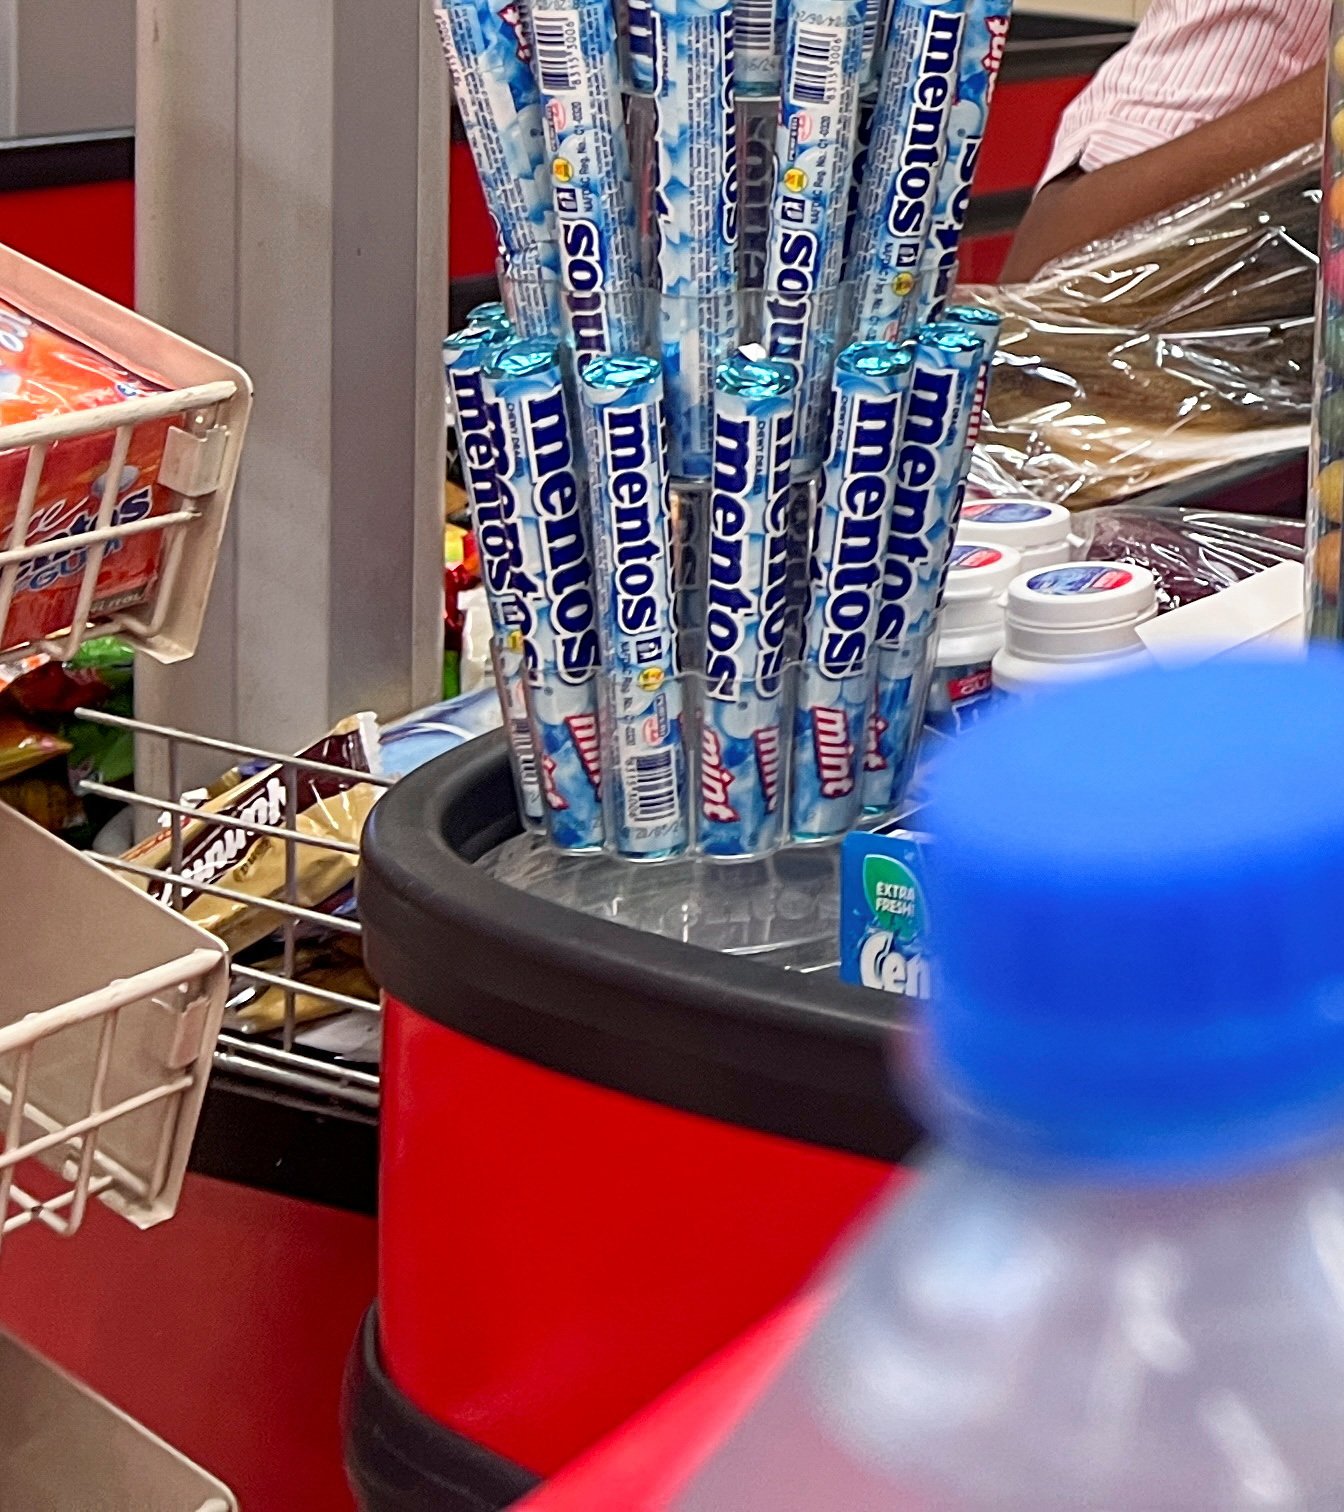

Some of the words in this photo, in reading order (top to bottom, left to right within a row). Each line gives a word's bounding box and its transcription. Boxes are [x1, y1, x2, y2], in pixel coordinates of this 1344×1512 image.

[888, 12, 966, 239] mentos
[450, 368, 514, 596] mentos
[522, 386, 602, 686] mentos
[604, 405, 662, 635] mentos
[705, 414, 755, 702] mentos
[818, 392, 903, 679] mentos
[875, 364, 960, 651] mentos
[813, 704, 856, 800] mint
[860, 930, 932, 1000] Cen
[875, 881, 916, 901] EXTRA
